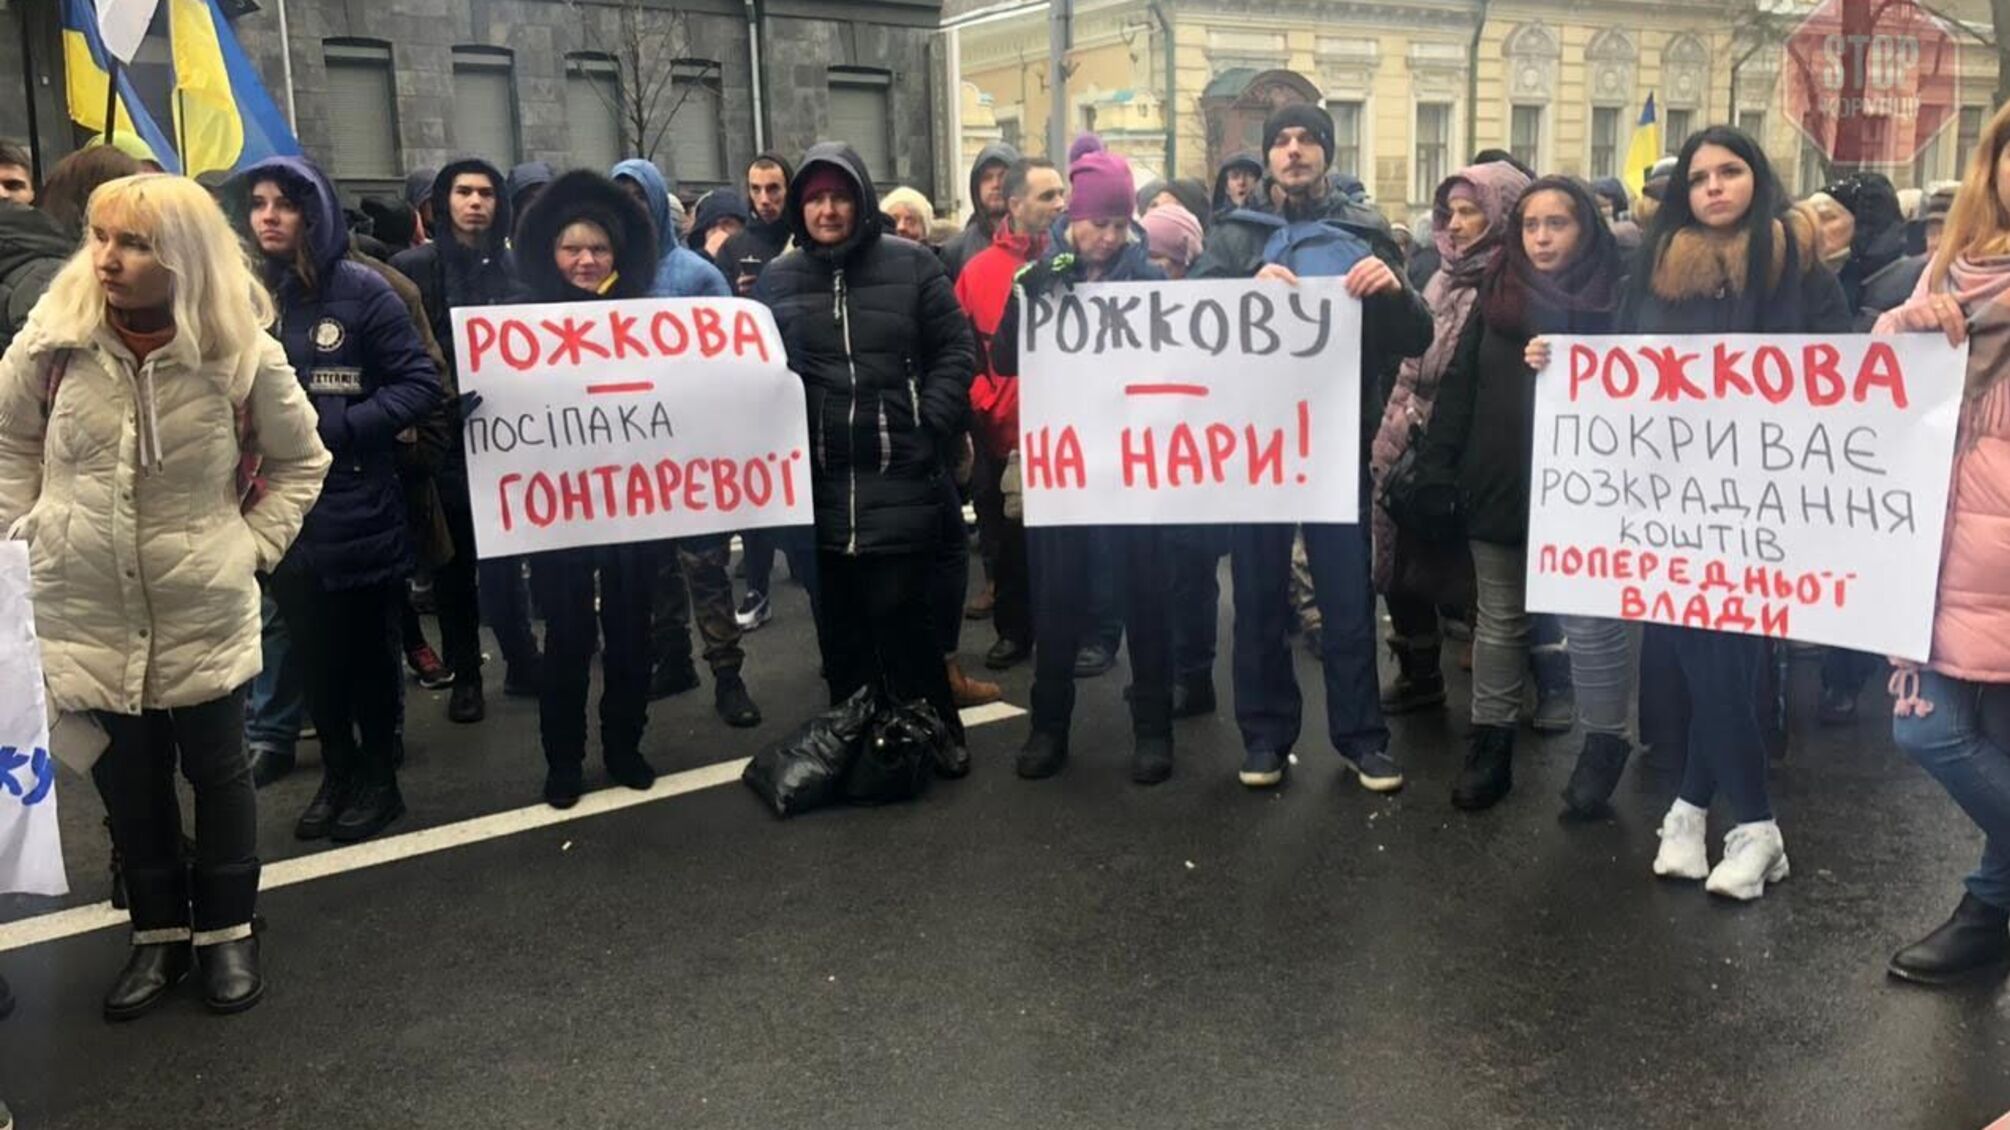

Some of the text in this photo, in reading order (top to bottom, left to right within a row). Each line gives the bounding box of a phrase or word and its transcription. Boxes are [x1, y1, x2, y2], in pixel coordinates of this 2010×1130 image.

[465, 306, 769, 372] РОЖКОВА
[1025, 290, 1331, 357] РОЖКОВУ
[1568, 341, 1909, 408] РОЖКОВА
[468, 401, 674, 454] ПОСІПАКА
[1025, 399, 1311, 490] НА НАРИ!
[1553, 413, 1886, 475] ПОКРИВАЄ
[1541, 468, 1916, 533] РОЗКРАДАННЯ
[1620, 516, 1786, 562] КОШТІВ
[1539, 544, 1857, 608] ПОПЕРЕДНЬОЇ
[1620, 586, 1790, 638] ВЛАДИ
